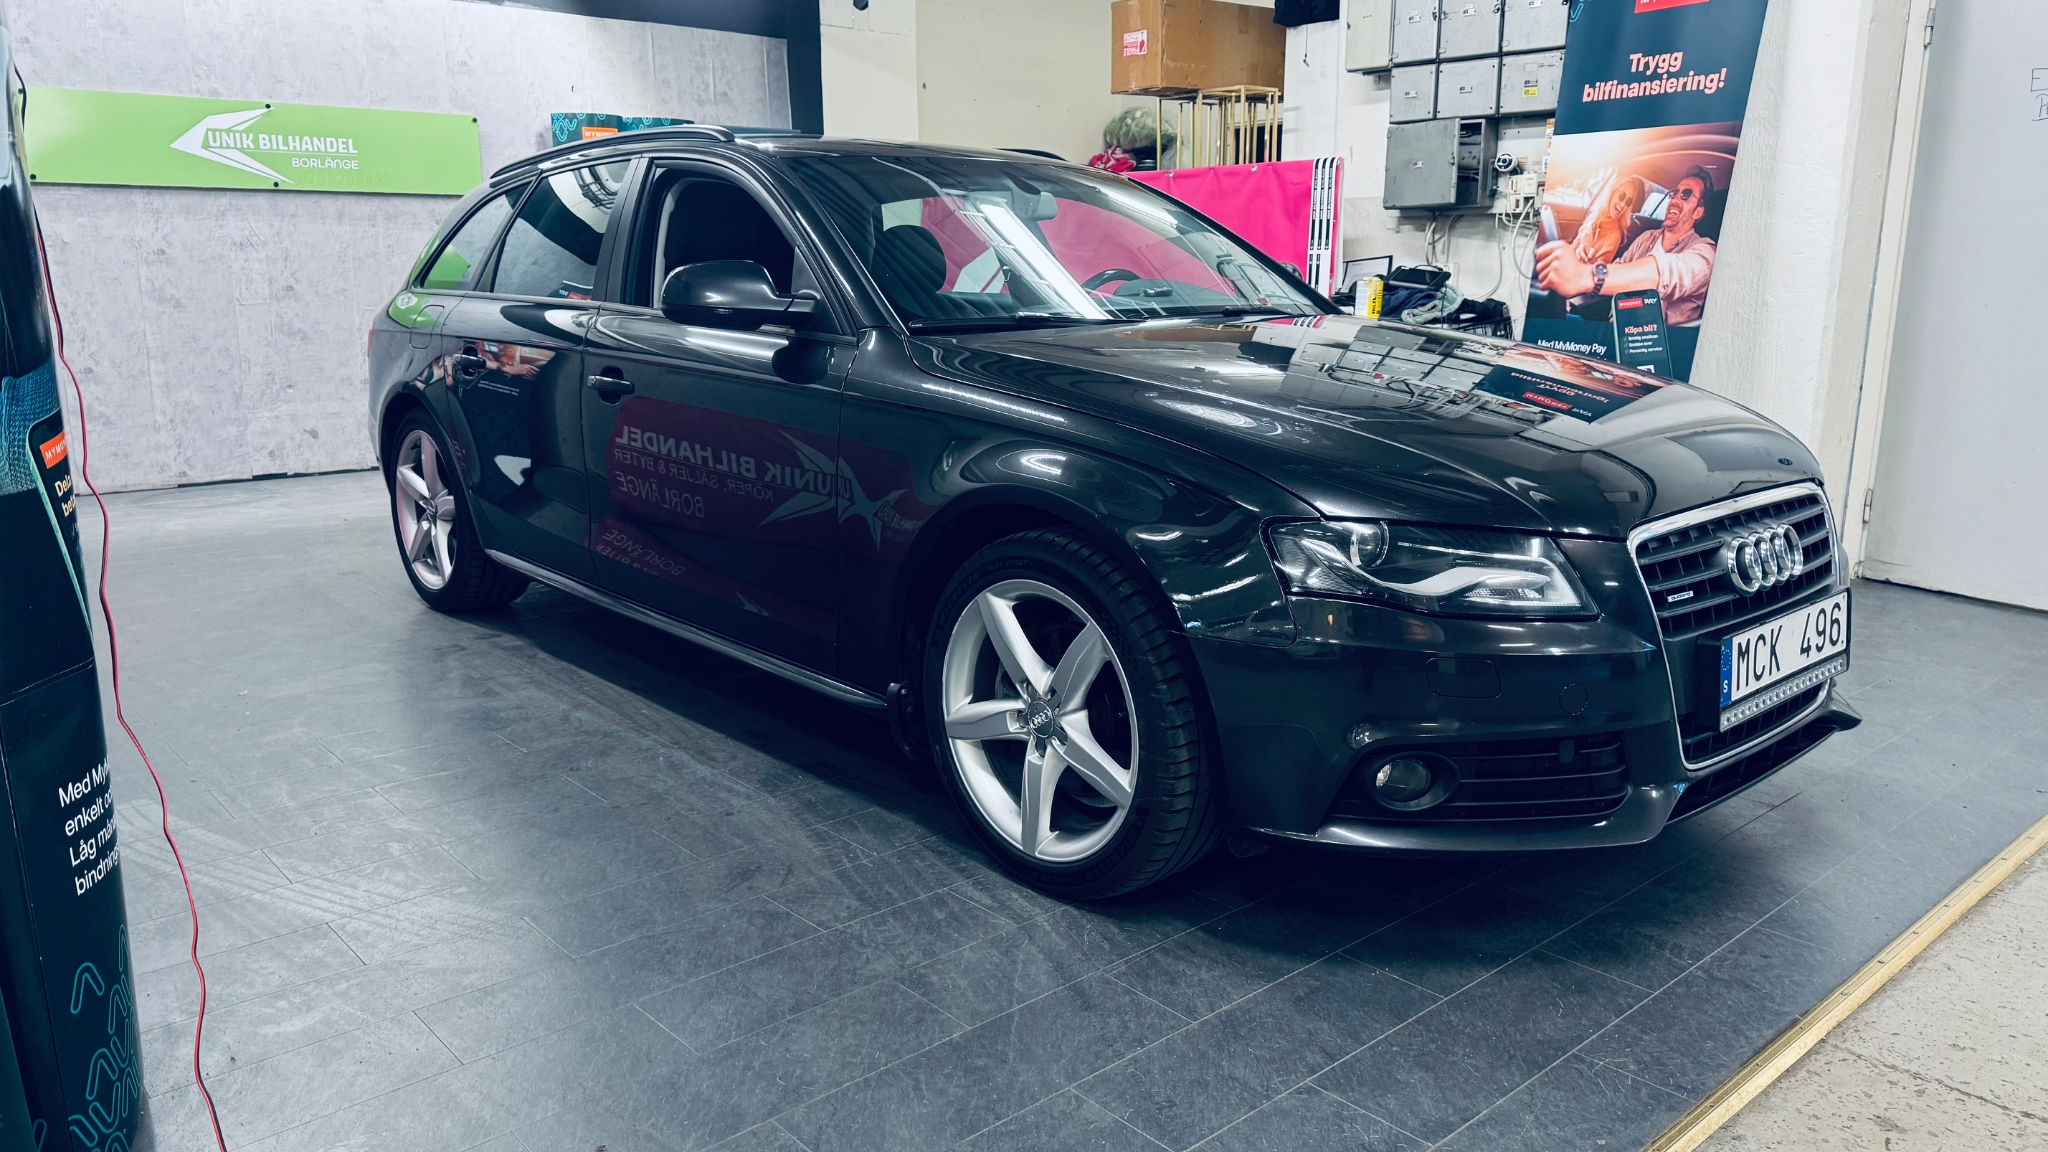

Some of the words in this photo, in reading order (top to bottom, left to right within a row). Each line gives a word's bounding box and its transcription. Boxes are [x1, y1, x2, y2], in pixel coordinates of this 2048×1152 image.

[1629, 51, 1684, 76] Trygg
[1582, 67, 1728, 103] bilfinansiering!
[207, 130, 255, 149] UNIK
[258, 133, 358, 154] BILHANDEL
[291, 156, 360, 170] BORLÄNGE
[1624, 325, 1643, 334] Köpa
[1643, 323, 1658, 332] bil?
[1554, 340, 1592, 354] MyMoney
[1592, 344, 1607, 356] Pay
[1736, 624, 1783, 692] MCK
[1799, 601, 1842, 659] 496
[1723, 678, 1729, 694] S
[58, 772, 92, 809] Med
[65, 796, 105, 837] enkelt
[69, 838, 97, 867] Låg
